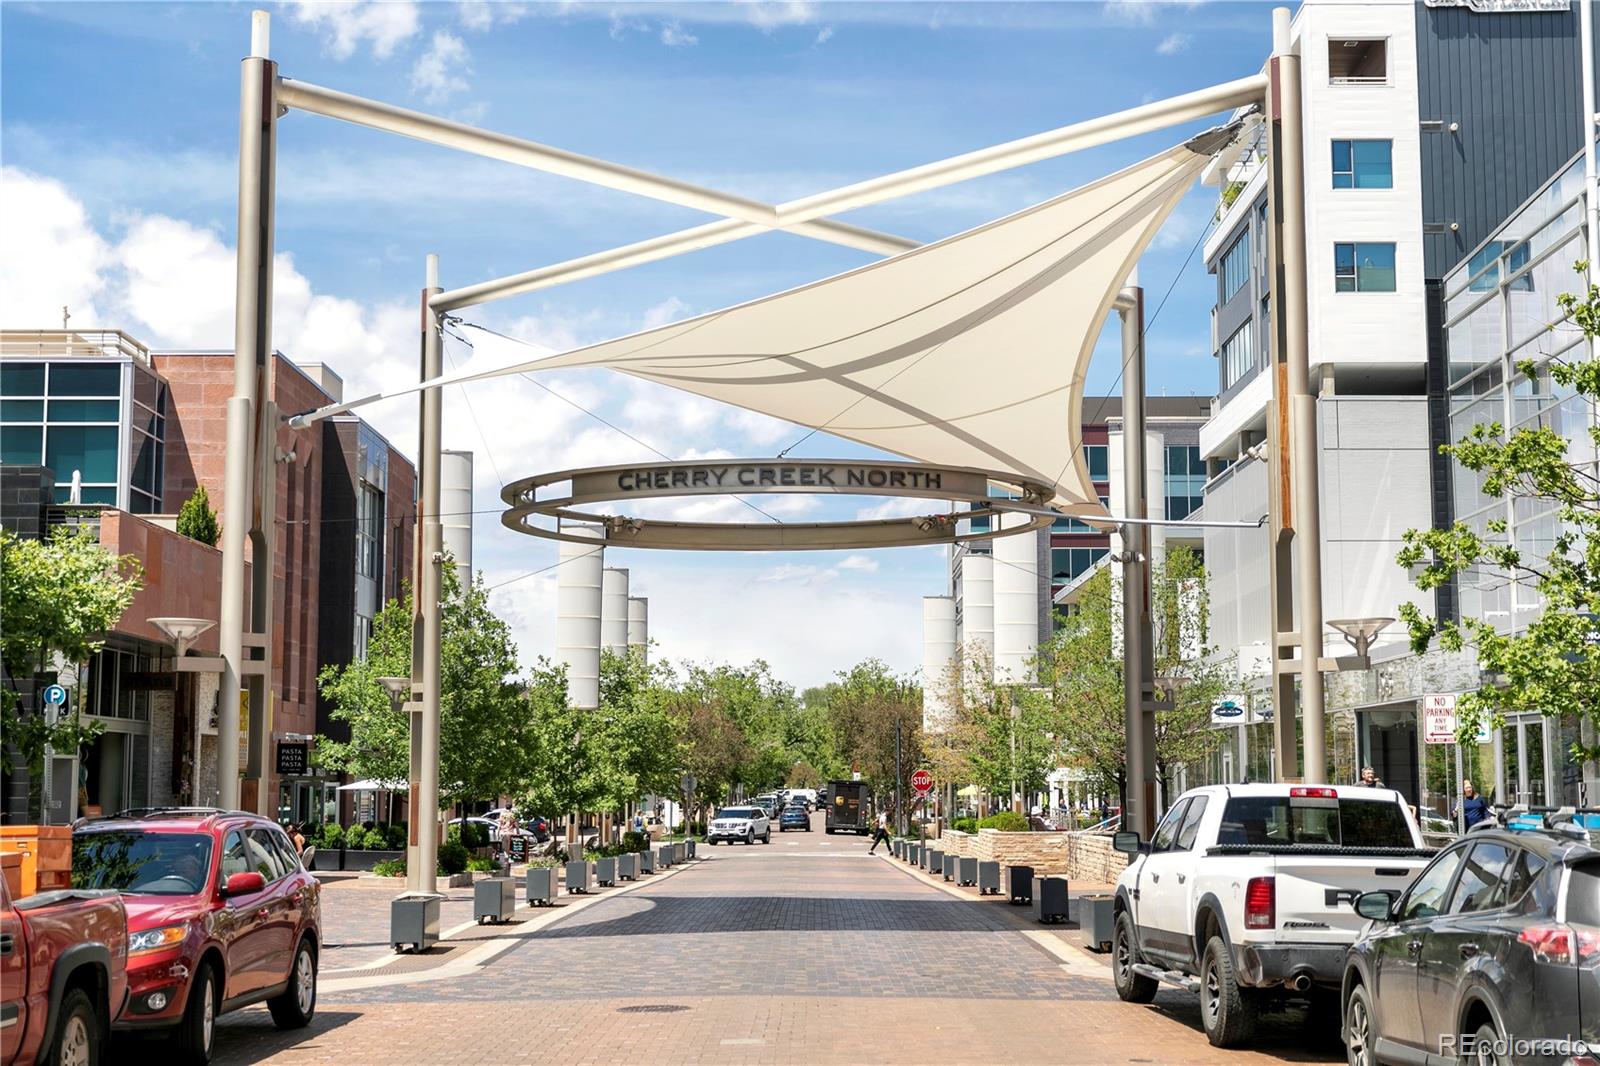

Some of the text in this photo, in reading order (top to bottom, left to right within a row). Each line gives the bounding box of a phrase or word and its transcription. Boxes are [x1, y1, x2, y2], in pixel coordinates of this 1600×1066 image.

[618, 467, 942, 491] CHERRY CREEK NORTH
[51, 689, 61, 702] P
[1433, 697, 1446, 707] NO
[1426, 707, 1455, 718] PARKING
[1434, 717, 1446, 725] ANY
[913, 776, 931, 786] STOP
